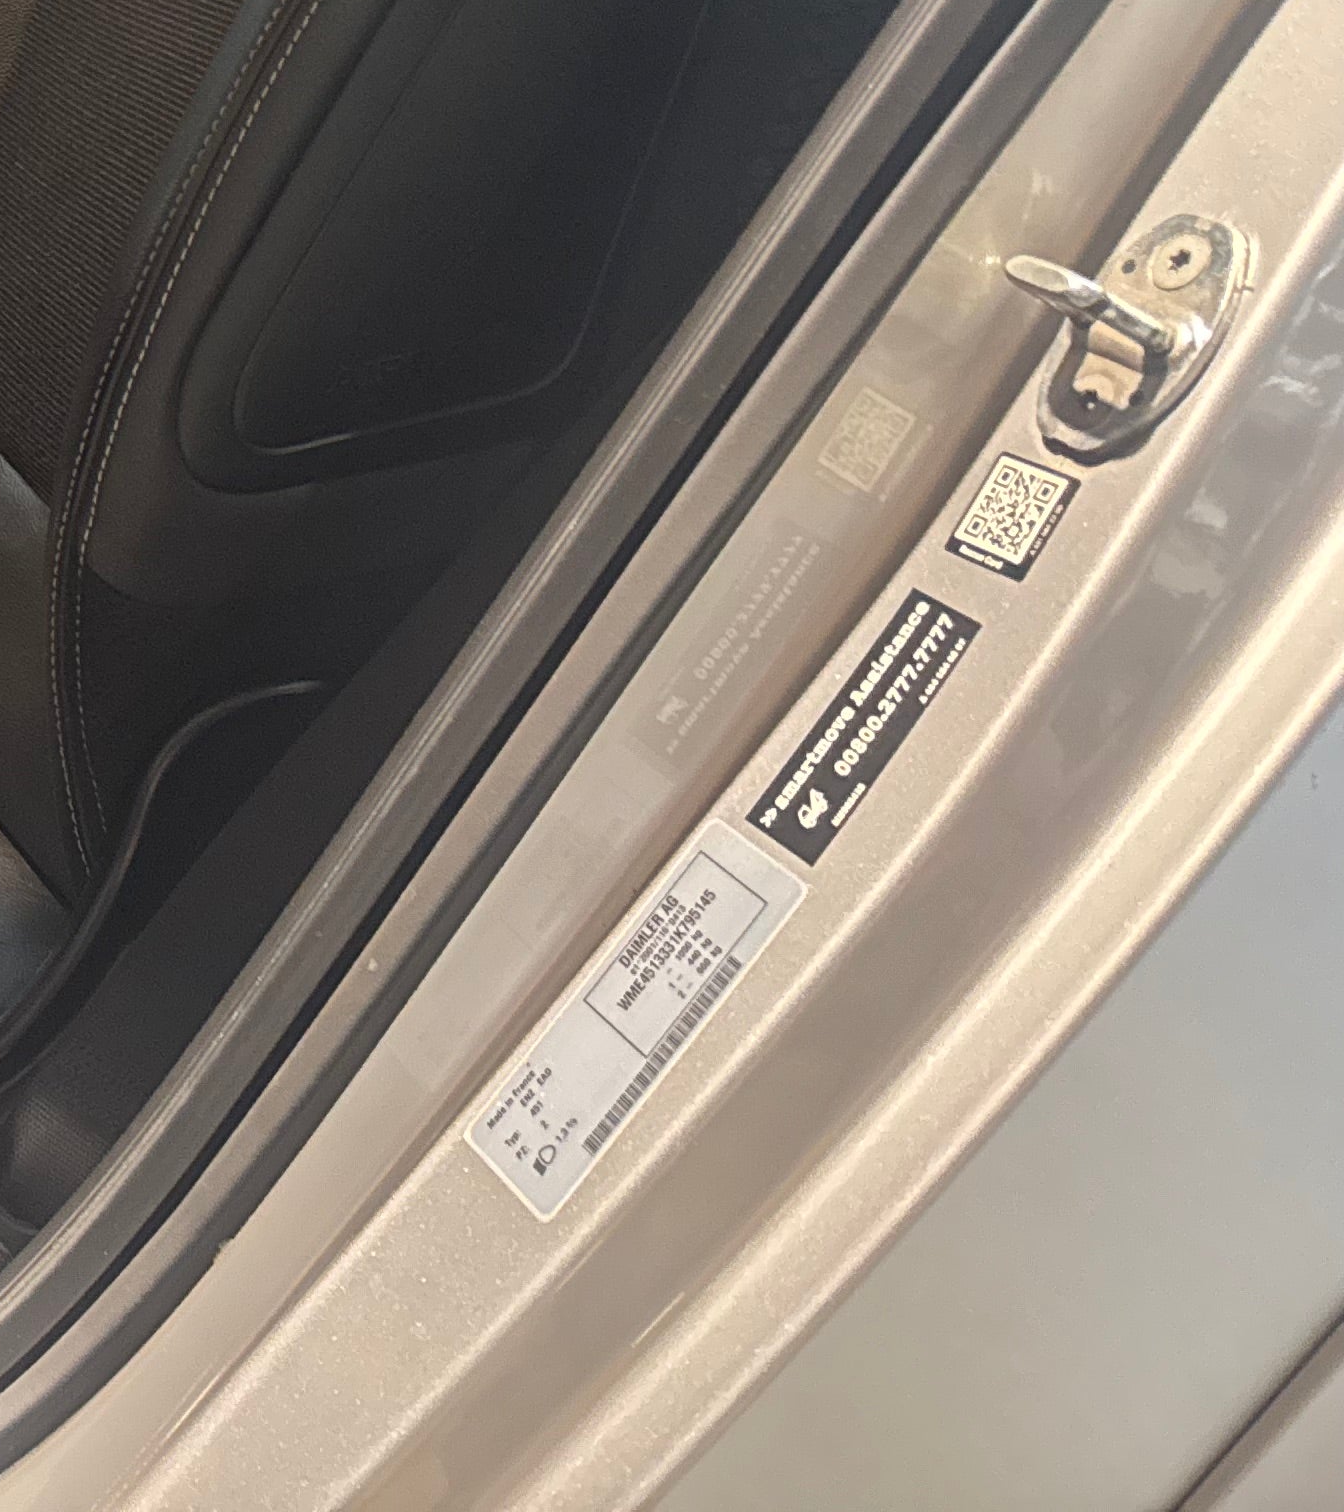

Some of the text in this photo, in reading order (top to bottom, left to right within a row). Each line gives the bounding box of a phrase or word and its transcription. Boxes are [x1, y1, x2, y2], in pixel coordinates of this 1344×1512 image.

[774, 705, 856, 810] smartmove
[849, 601, 930, 707] Assistance
[833, 612, 955, 777] 00800.2777.7777
[616, 888, 717, 1012] WME4513331K795145
[618, 894, 679, 969] DAIMLER AG
[486, 1106, 507, 1130] Made
